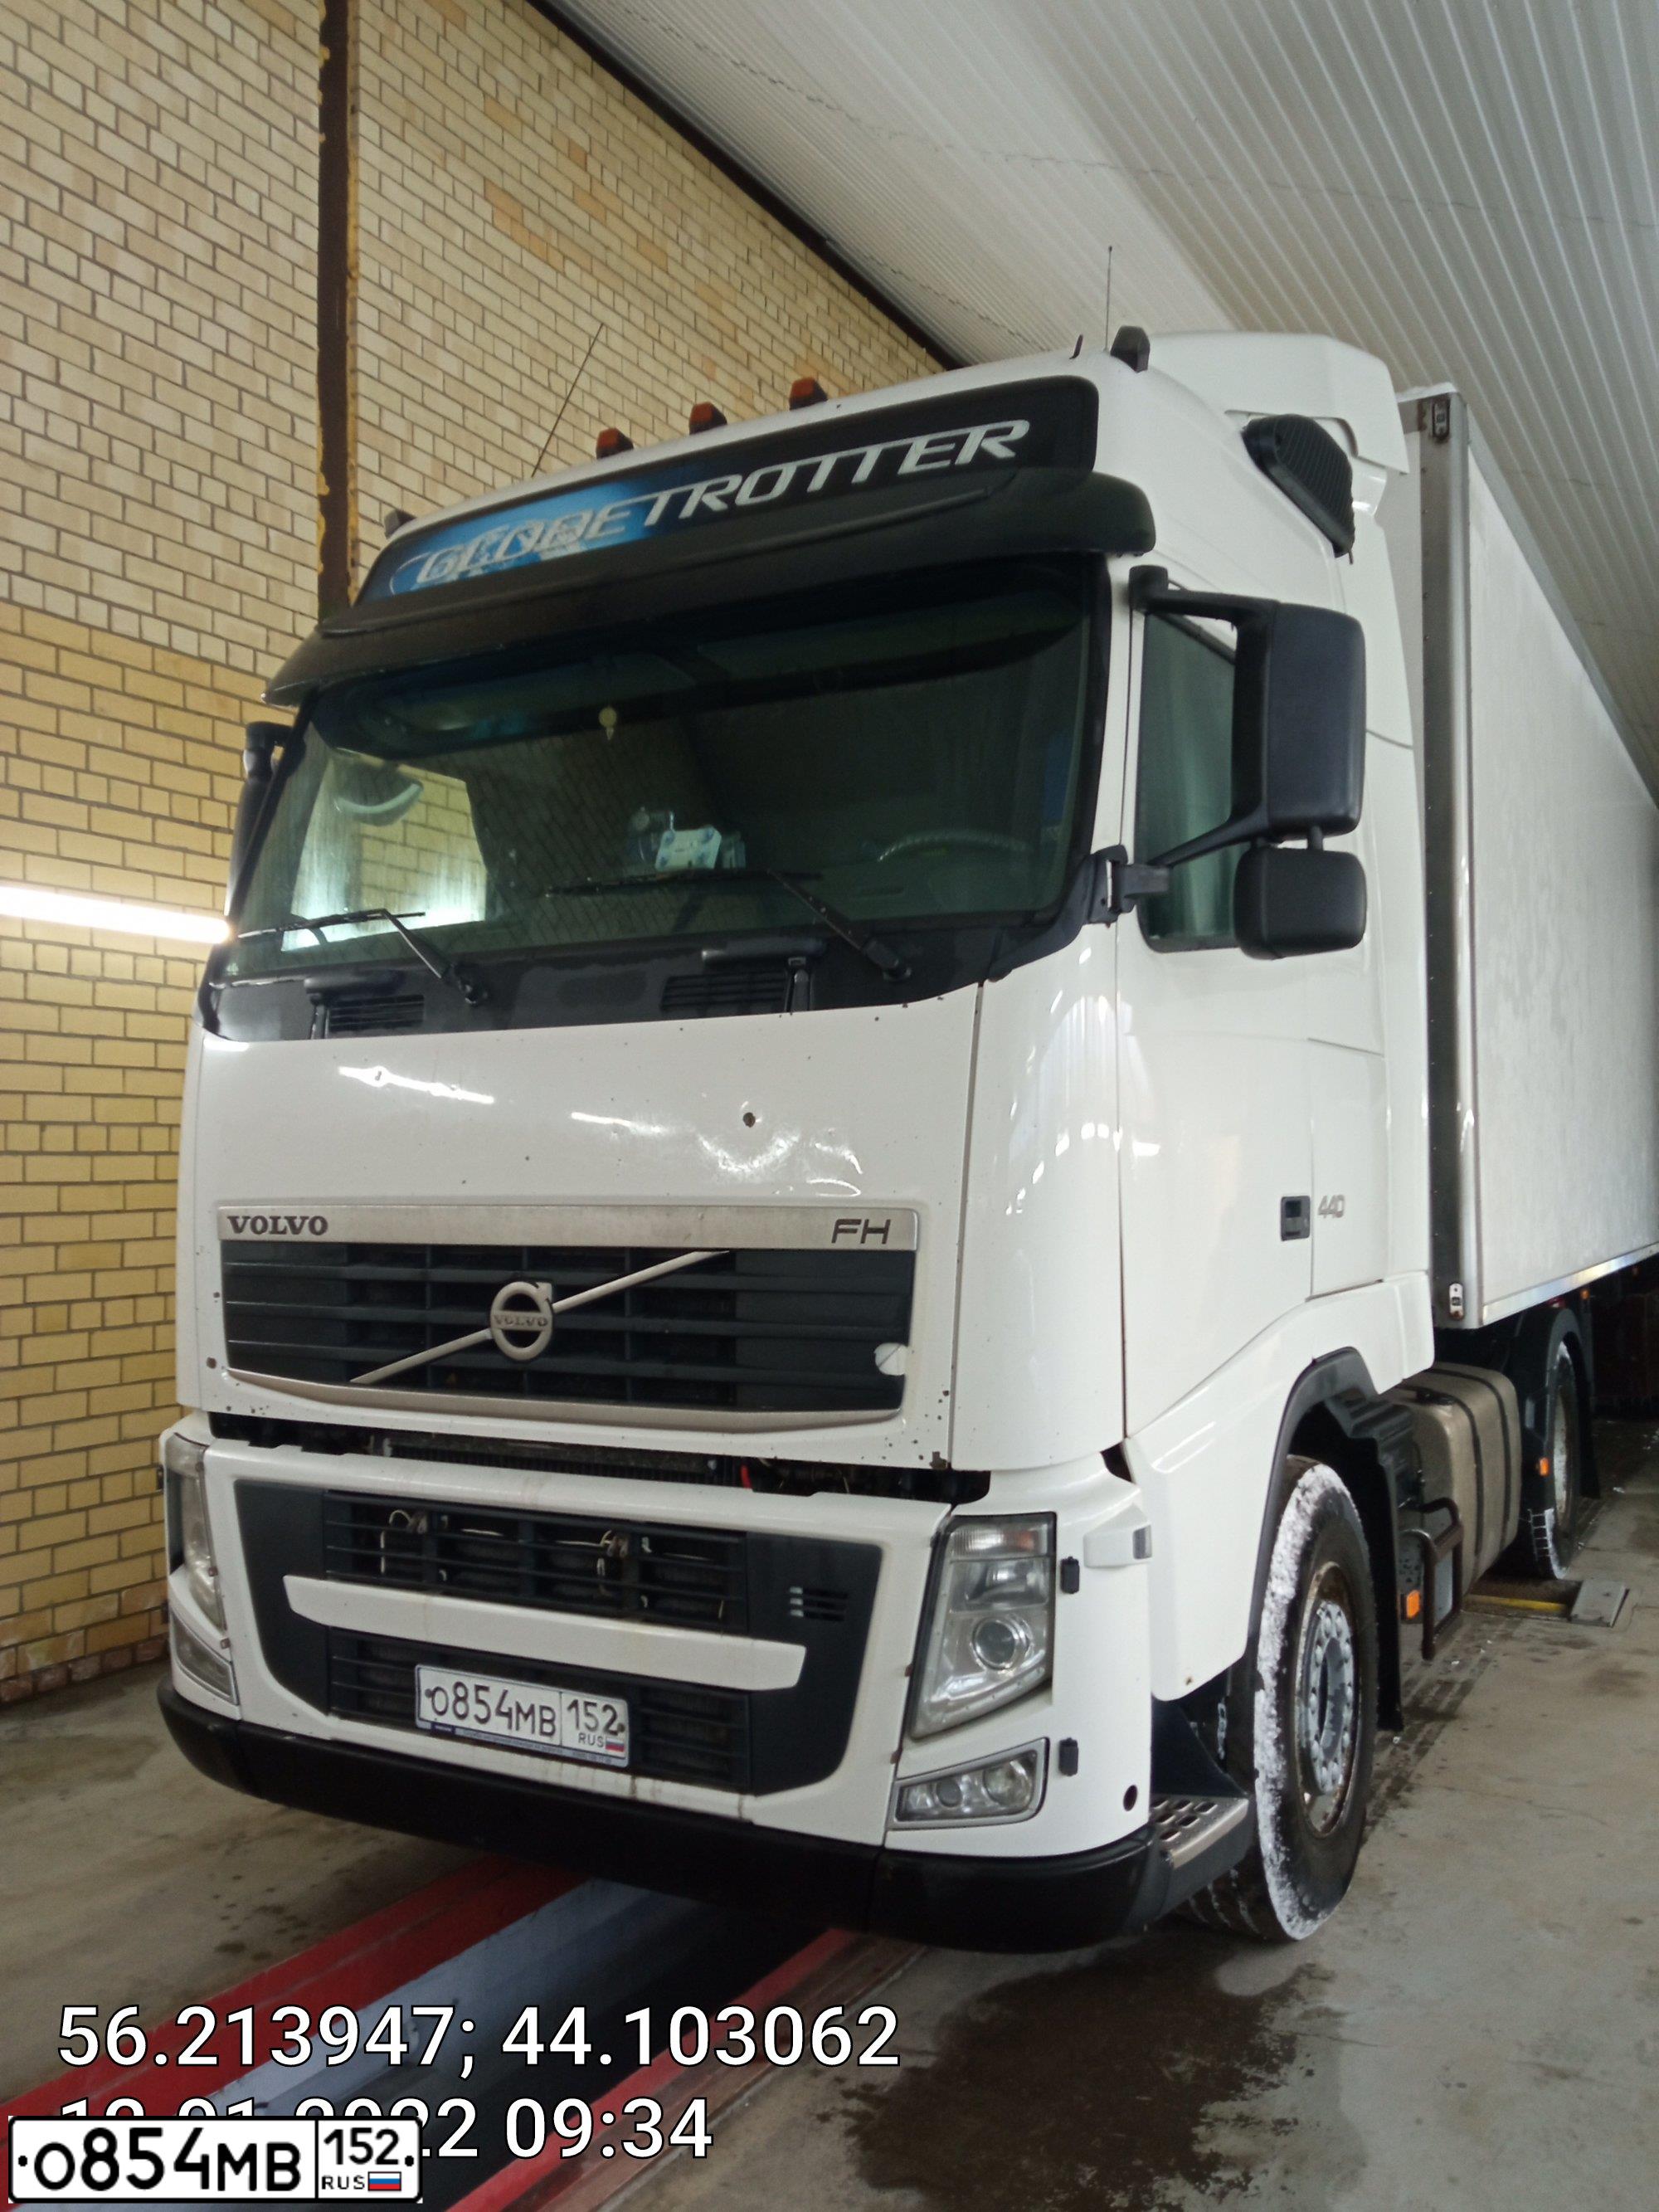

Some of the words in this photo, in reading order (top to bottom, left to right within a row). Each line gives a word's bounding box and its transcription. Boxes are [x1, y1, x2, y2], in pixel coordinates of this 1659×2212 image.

[415, 419, 1030, 584] GLOBETROTTER
[1317, 1194, 1345, 1219] 440
[227, 1215, 328, 1235] VOLVO
[831, 1219, 891, 1245] FH
[493, 1314, 548, 1327] VOLVO
[567, 1698, 620, 1736] 152
[578, 1732, 604, 1748] RUS
